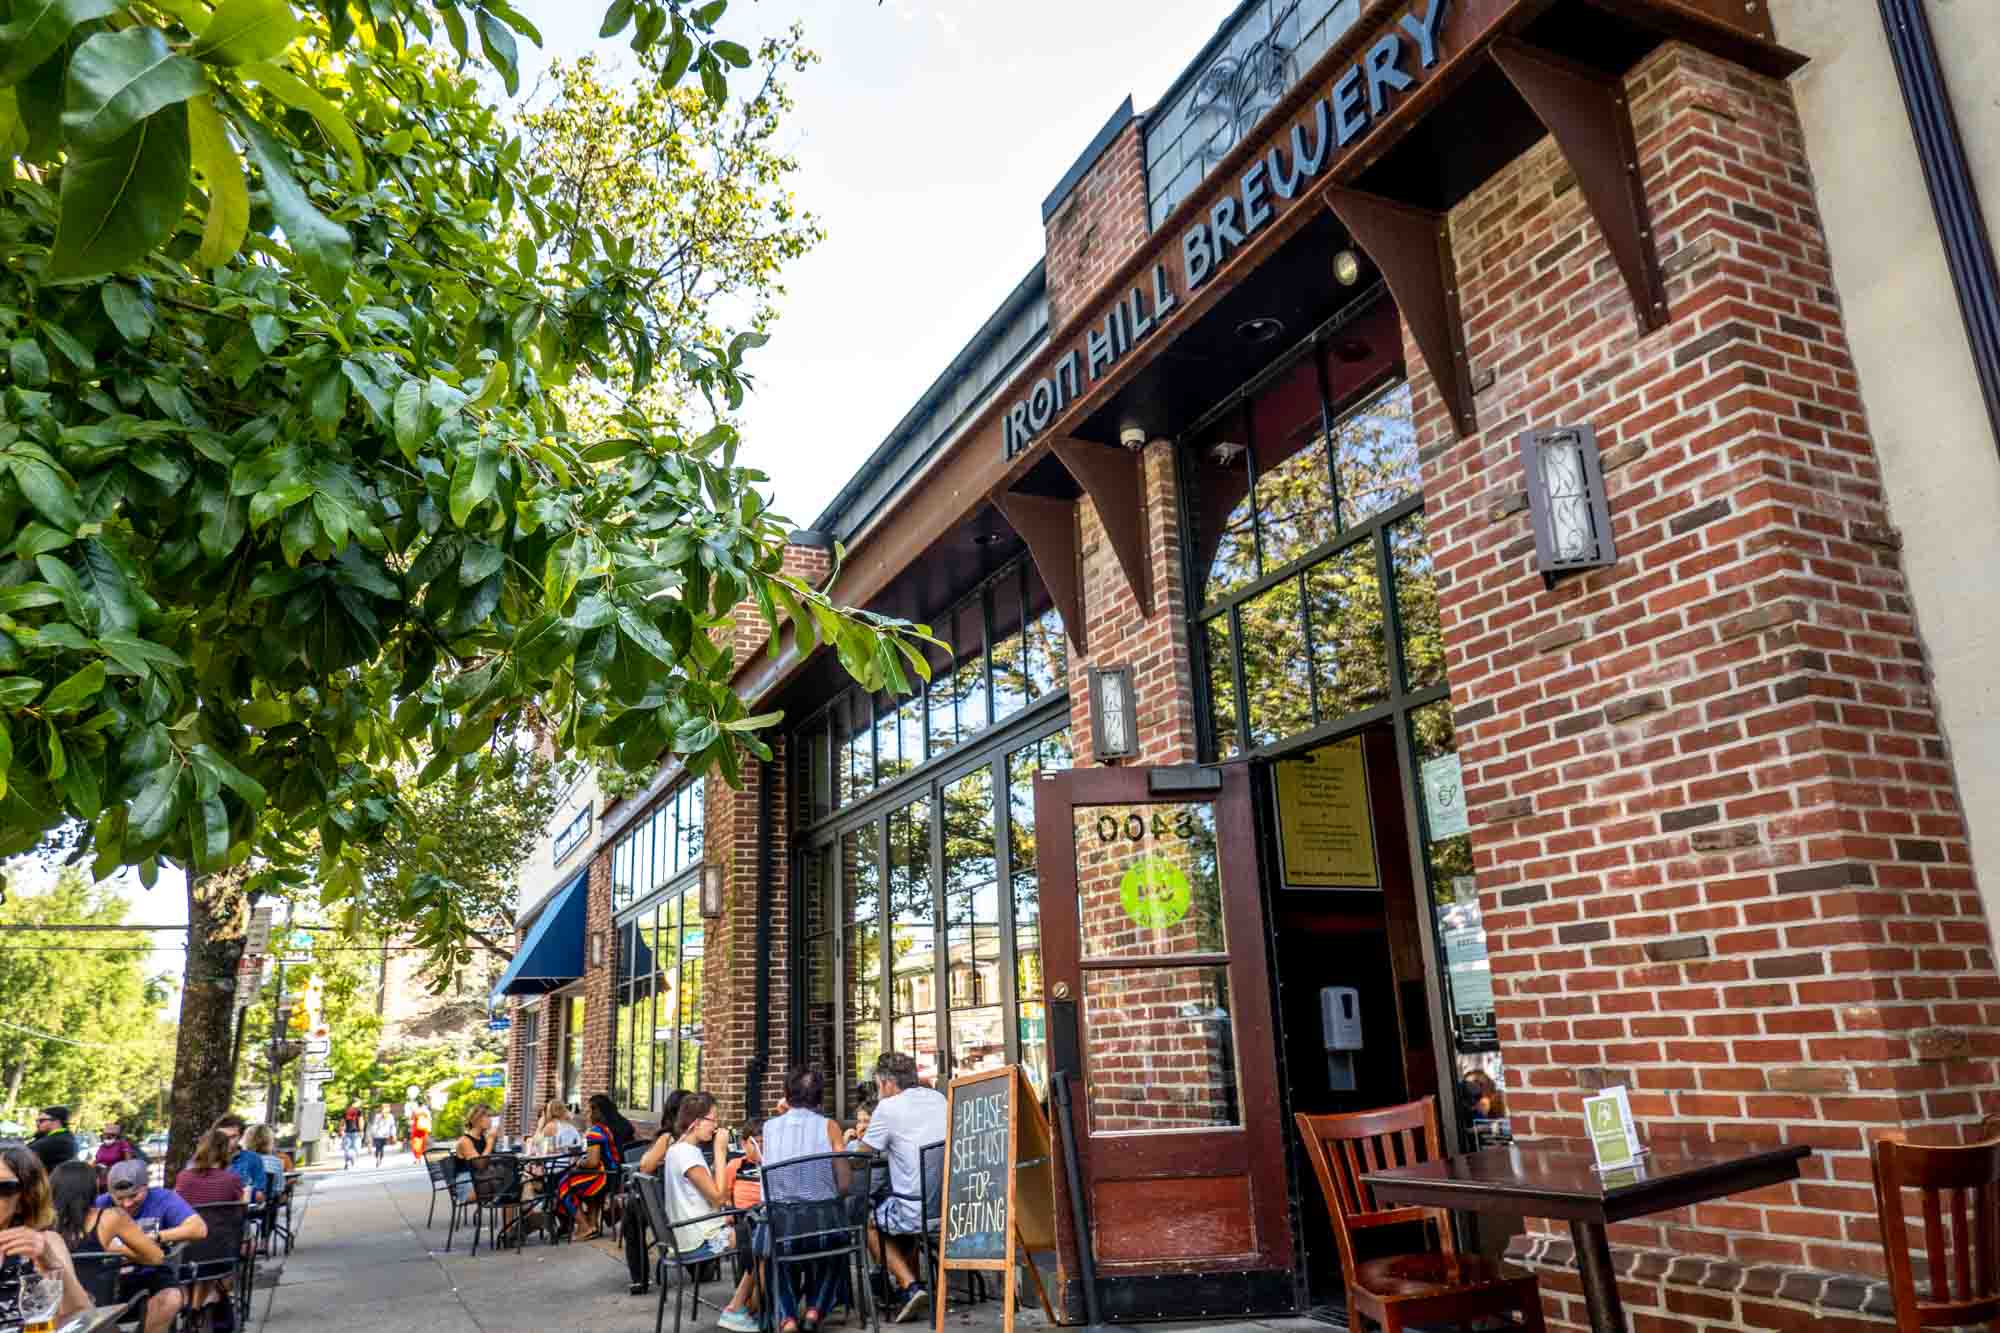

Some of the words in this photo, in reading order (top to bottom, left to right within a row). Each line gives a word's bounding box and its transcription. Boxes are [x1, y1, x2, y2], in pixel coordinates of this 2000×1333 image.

[1003, 349, 1082, 461] IRON
[1088, 264, 1175, 381] HILL
[1183, 0, 1441, 289] BREWERY
[962, 1094, 1003, 1137] PLEASE
[952, 1136, 977, 1174] SEE
[978, 1128, 1009, 1167] HOST
[968, 1170, 991, 1201] FOR
[949, 1196, 1006, 1241] SEATING
